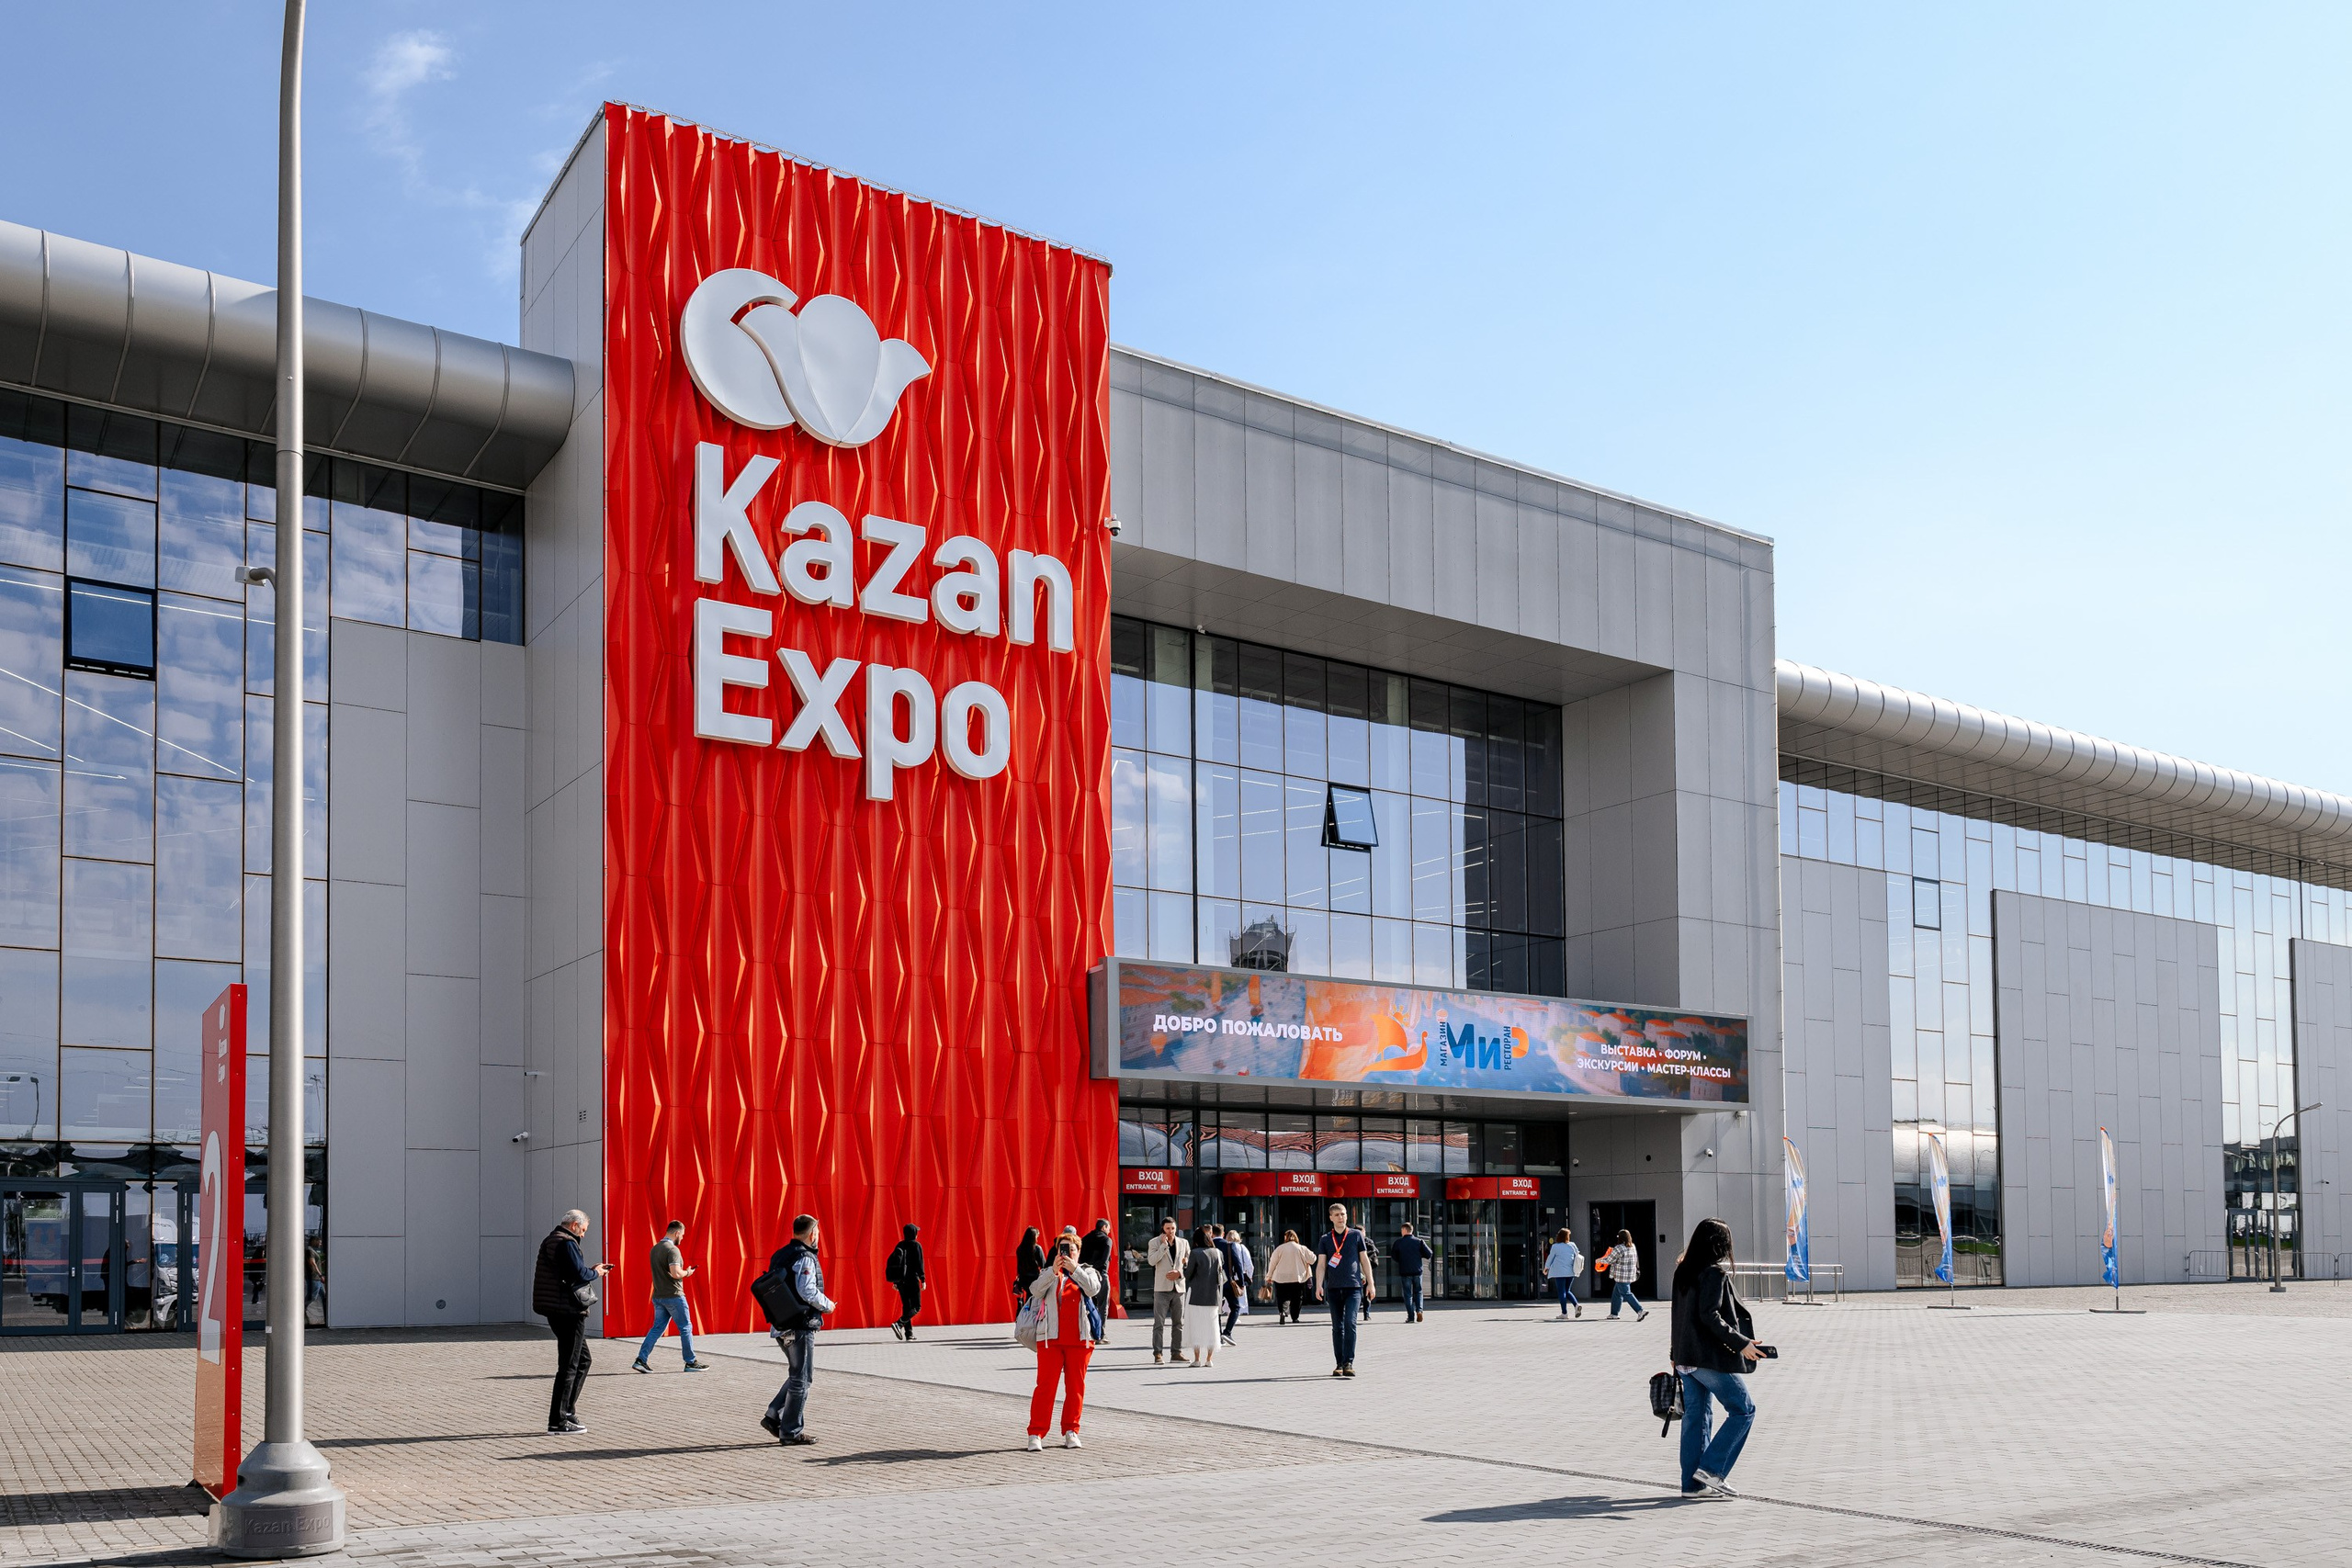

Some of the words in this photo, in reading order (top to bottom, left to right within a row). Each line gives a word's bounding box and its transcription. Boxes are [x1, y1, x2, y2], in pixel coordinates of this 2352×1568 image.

[694, 441, 1074, 654] Kazan
[694, 597, 1011, 802] Expo
[1152, 1014, 1217, 1033] ДОБРО
[1221, 1019, 1343, 1043] ПОЖАЛОВАТЬ
[1439, 1021, 1448, 1066] МАГАЗИН
[1503, 1025, 1512, 1071] РЕСТОРАН
[1600, 1043, 1657, 1058] ВЫСТАВКА
[1664, 1048, 1702, 1062] ФОРУМ
[1577, 1057, 1639, 1073] ЭКСКУРСИИ
[1646, 1064, 1731, 1078] МАСТЕР-КЛАССЫ
[1138, 1171, 1164, 1182] ВХОД
[1292, 1174, 1316, 1184] ВХОД
[1387, 1177, 1409, 1186] ВХОД
[1512, 1179, 1532, 1189] ВХОД
[244, 1518, 293, 1535] Kazan
[295, 1515, 332, 1533] Expo
